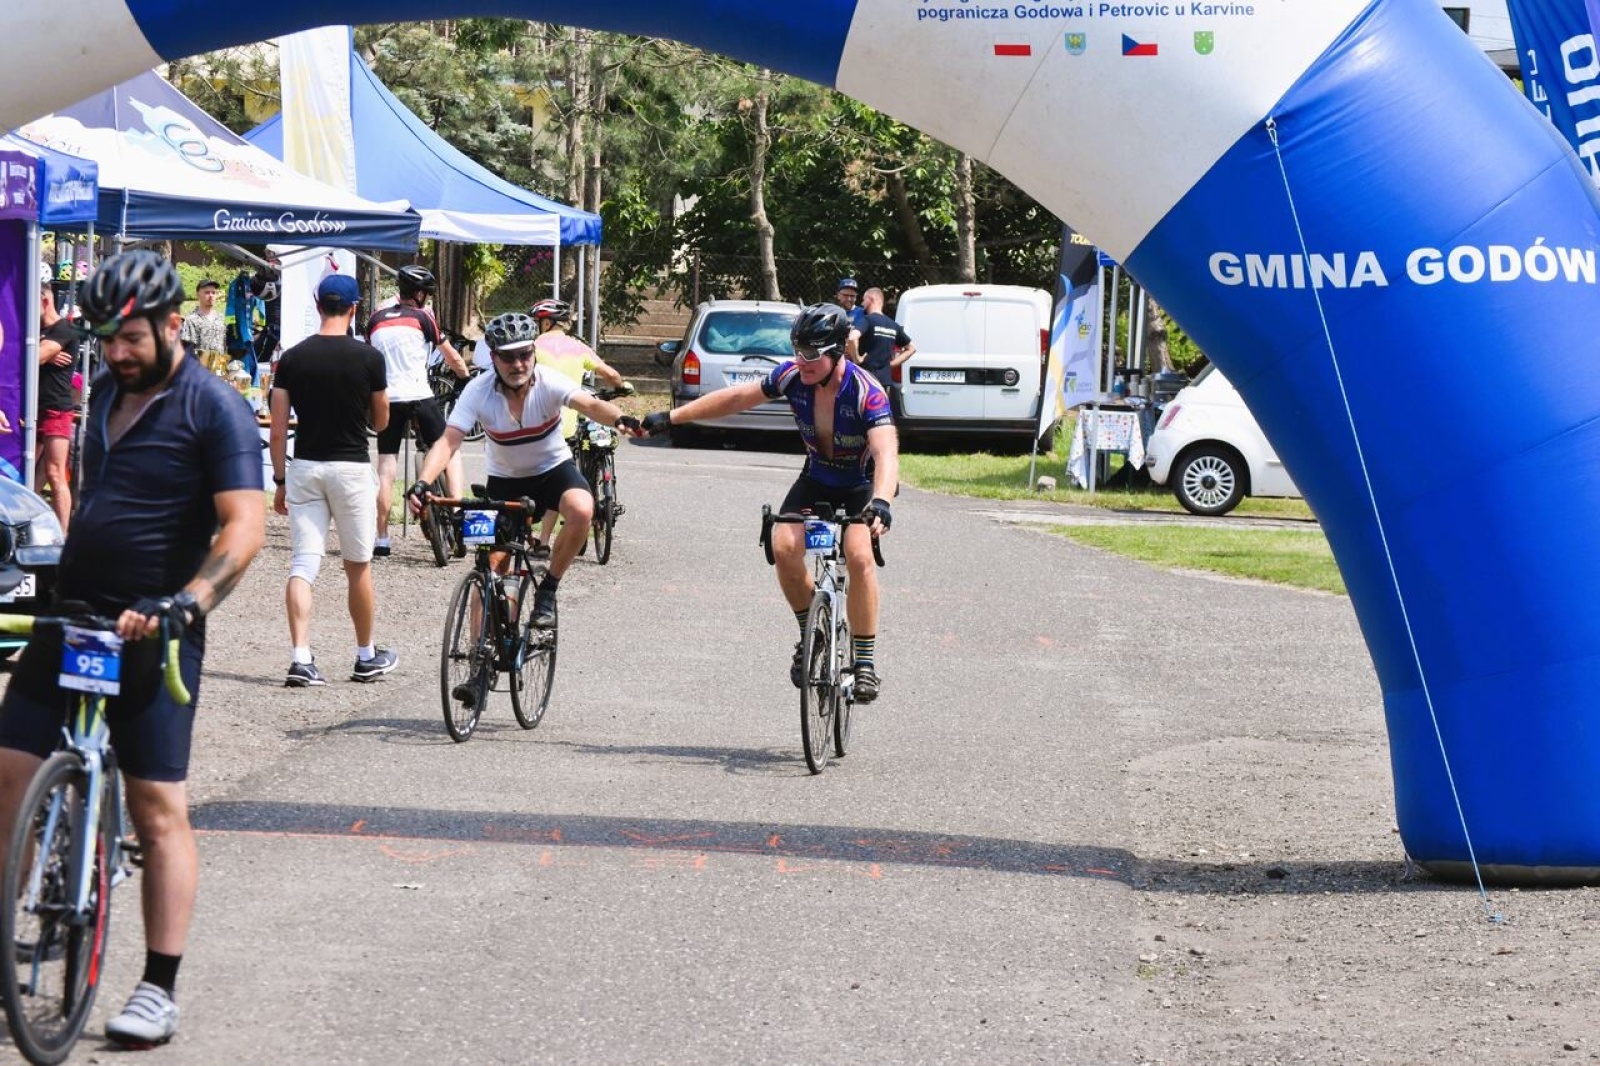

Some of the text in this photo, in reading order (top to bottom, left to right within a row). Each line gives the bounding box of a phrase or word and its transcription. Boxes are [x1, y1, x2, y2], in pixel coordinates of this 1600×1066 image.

[917, 3, 1255, 22] pogranicza Godowa i Petrovic u Karvine
[213, 208, 346, 233] Gmina Godów
[1208, 237, 1597, 289] GMINA GODÓW
[469, 523, 489, 535] 176
[809, 534, 827, 546] 175
[76, 654, 105, 676] 95
